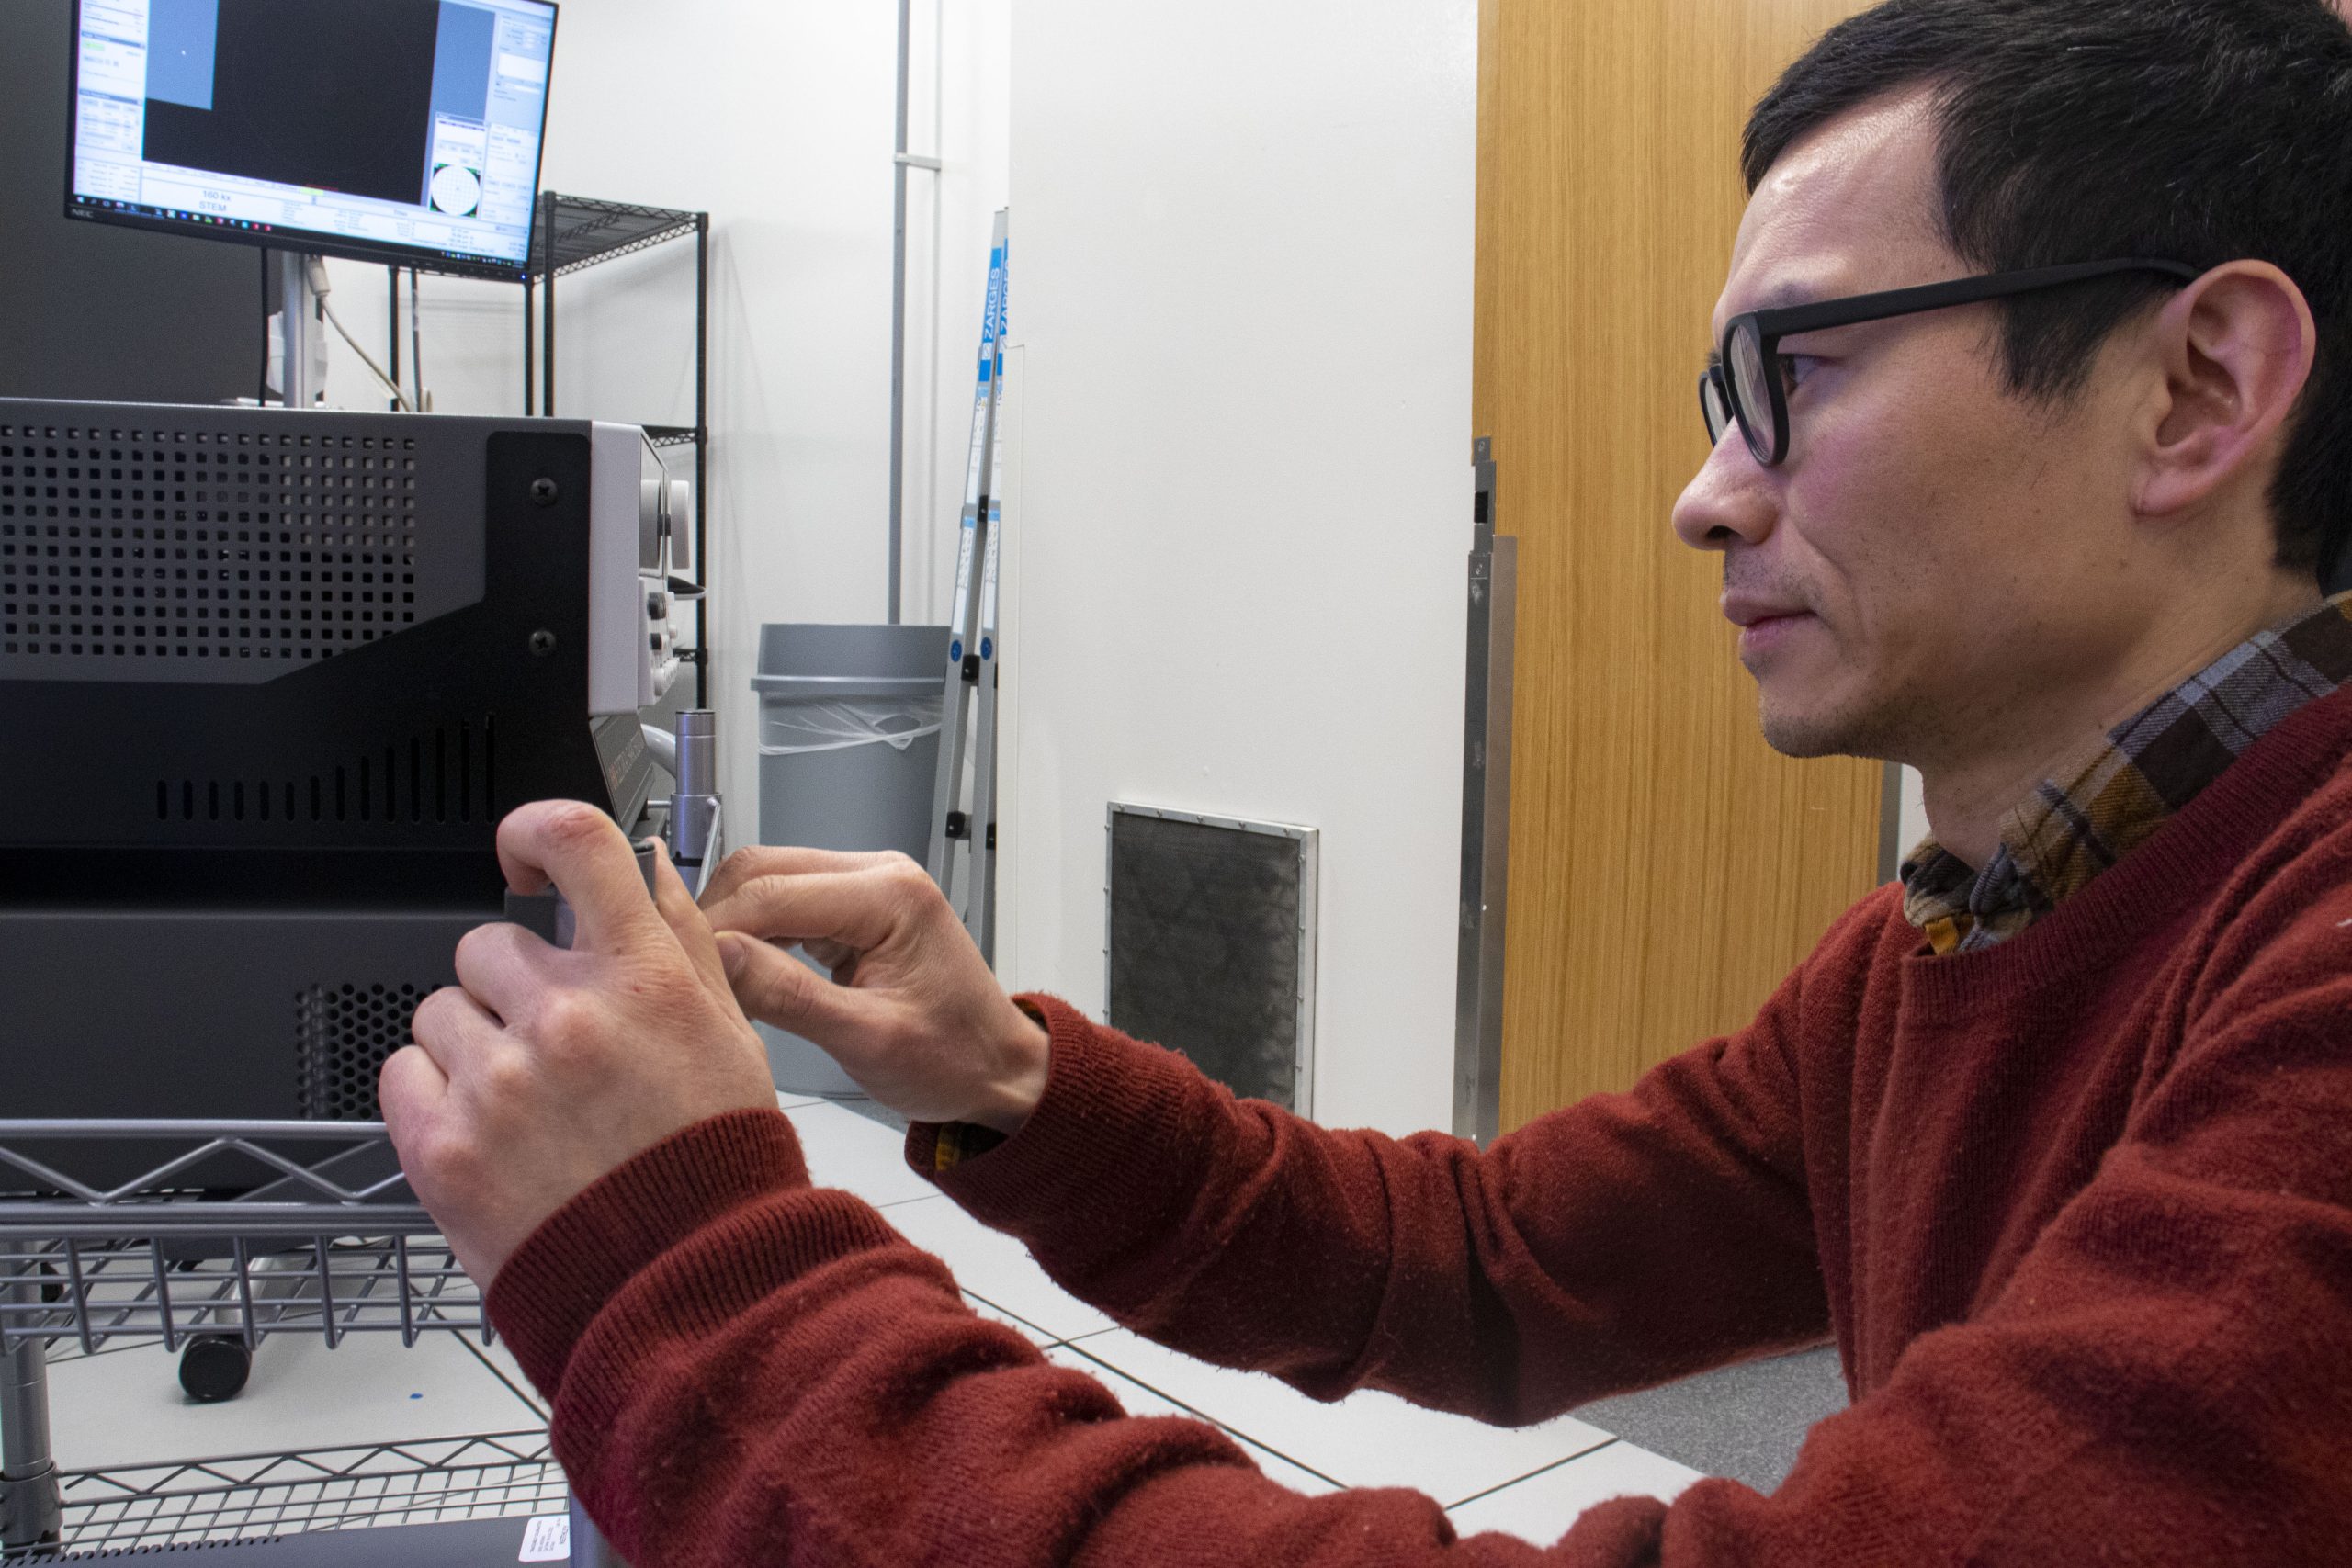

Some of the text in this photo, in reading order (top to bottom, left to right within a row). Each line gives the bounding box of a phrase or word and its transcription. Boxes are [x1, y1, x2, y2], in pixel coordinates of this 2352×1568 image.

[198, 200, 227, 212] STEM
[72, 208, 93, 219] NEC
[984, 267, 1000, 340] ZARGES
